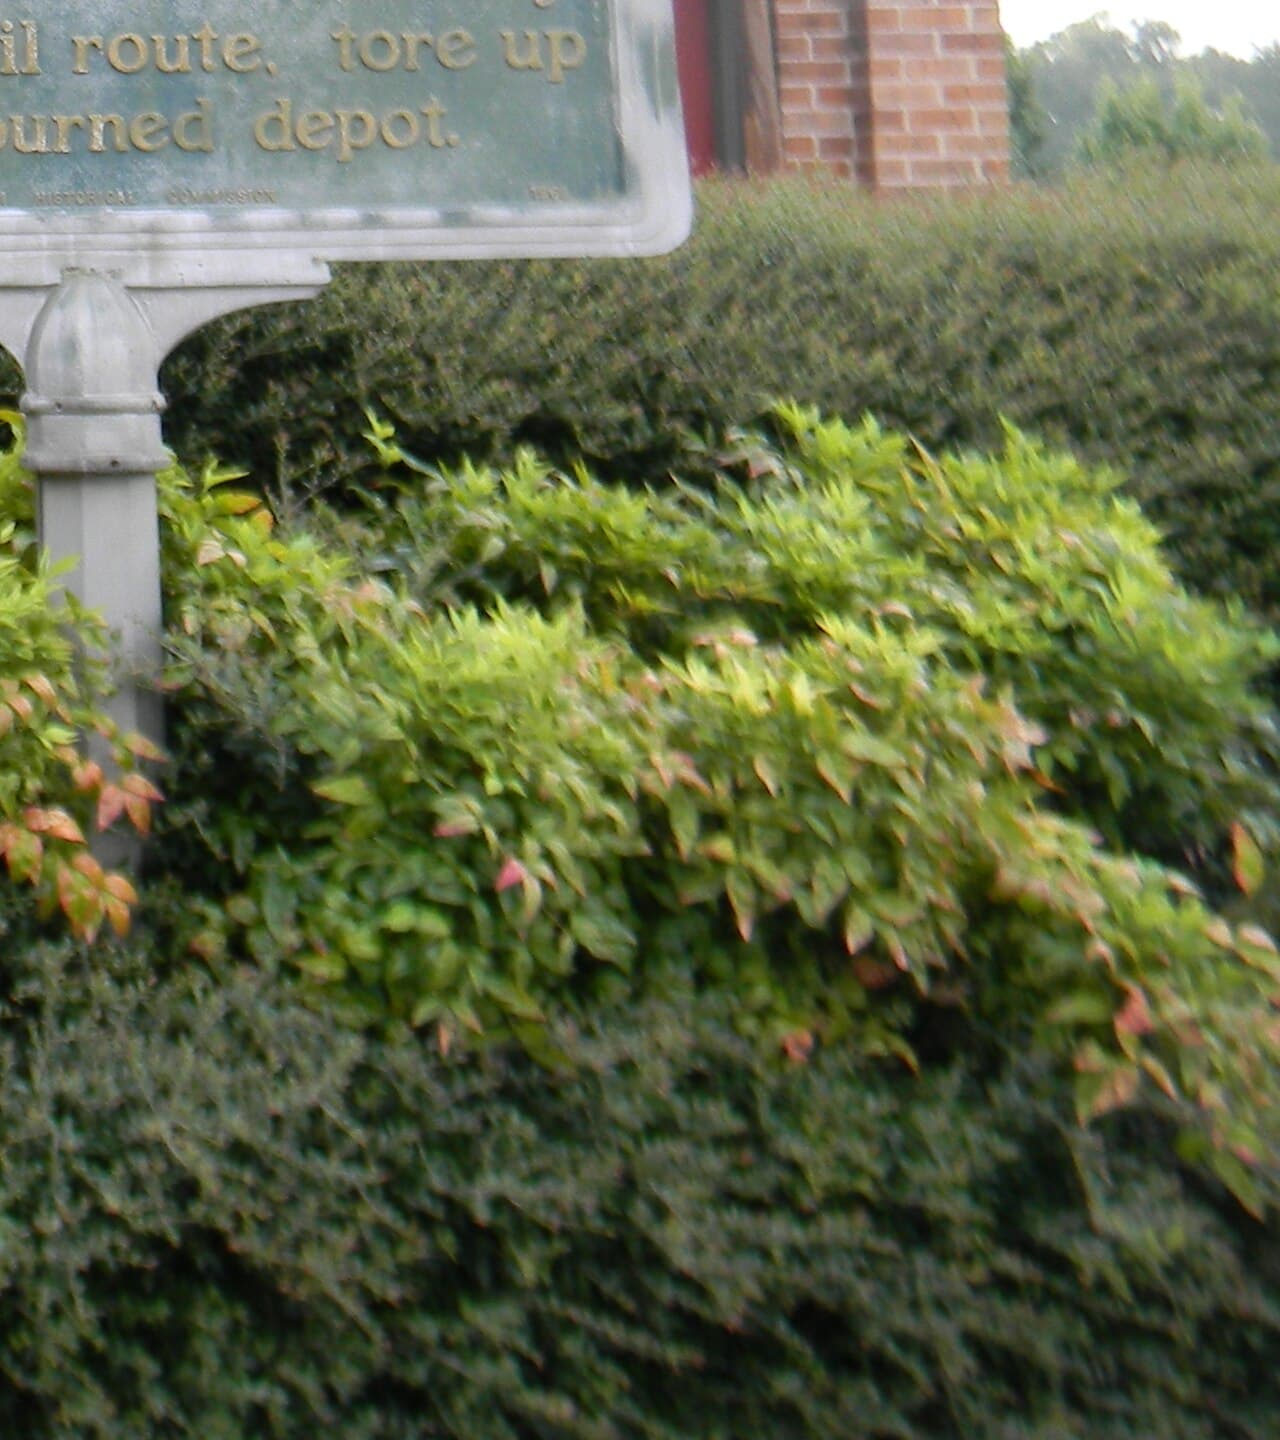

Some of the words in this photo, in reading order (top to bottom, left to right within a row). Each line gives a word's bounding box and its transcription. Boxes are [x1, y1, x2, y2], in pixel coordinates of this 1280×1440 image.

[330, 23, 479, 74] tore
[499, 29, 589, 85] up
[252, 95, 462, 164] depot.
